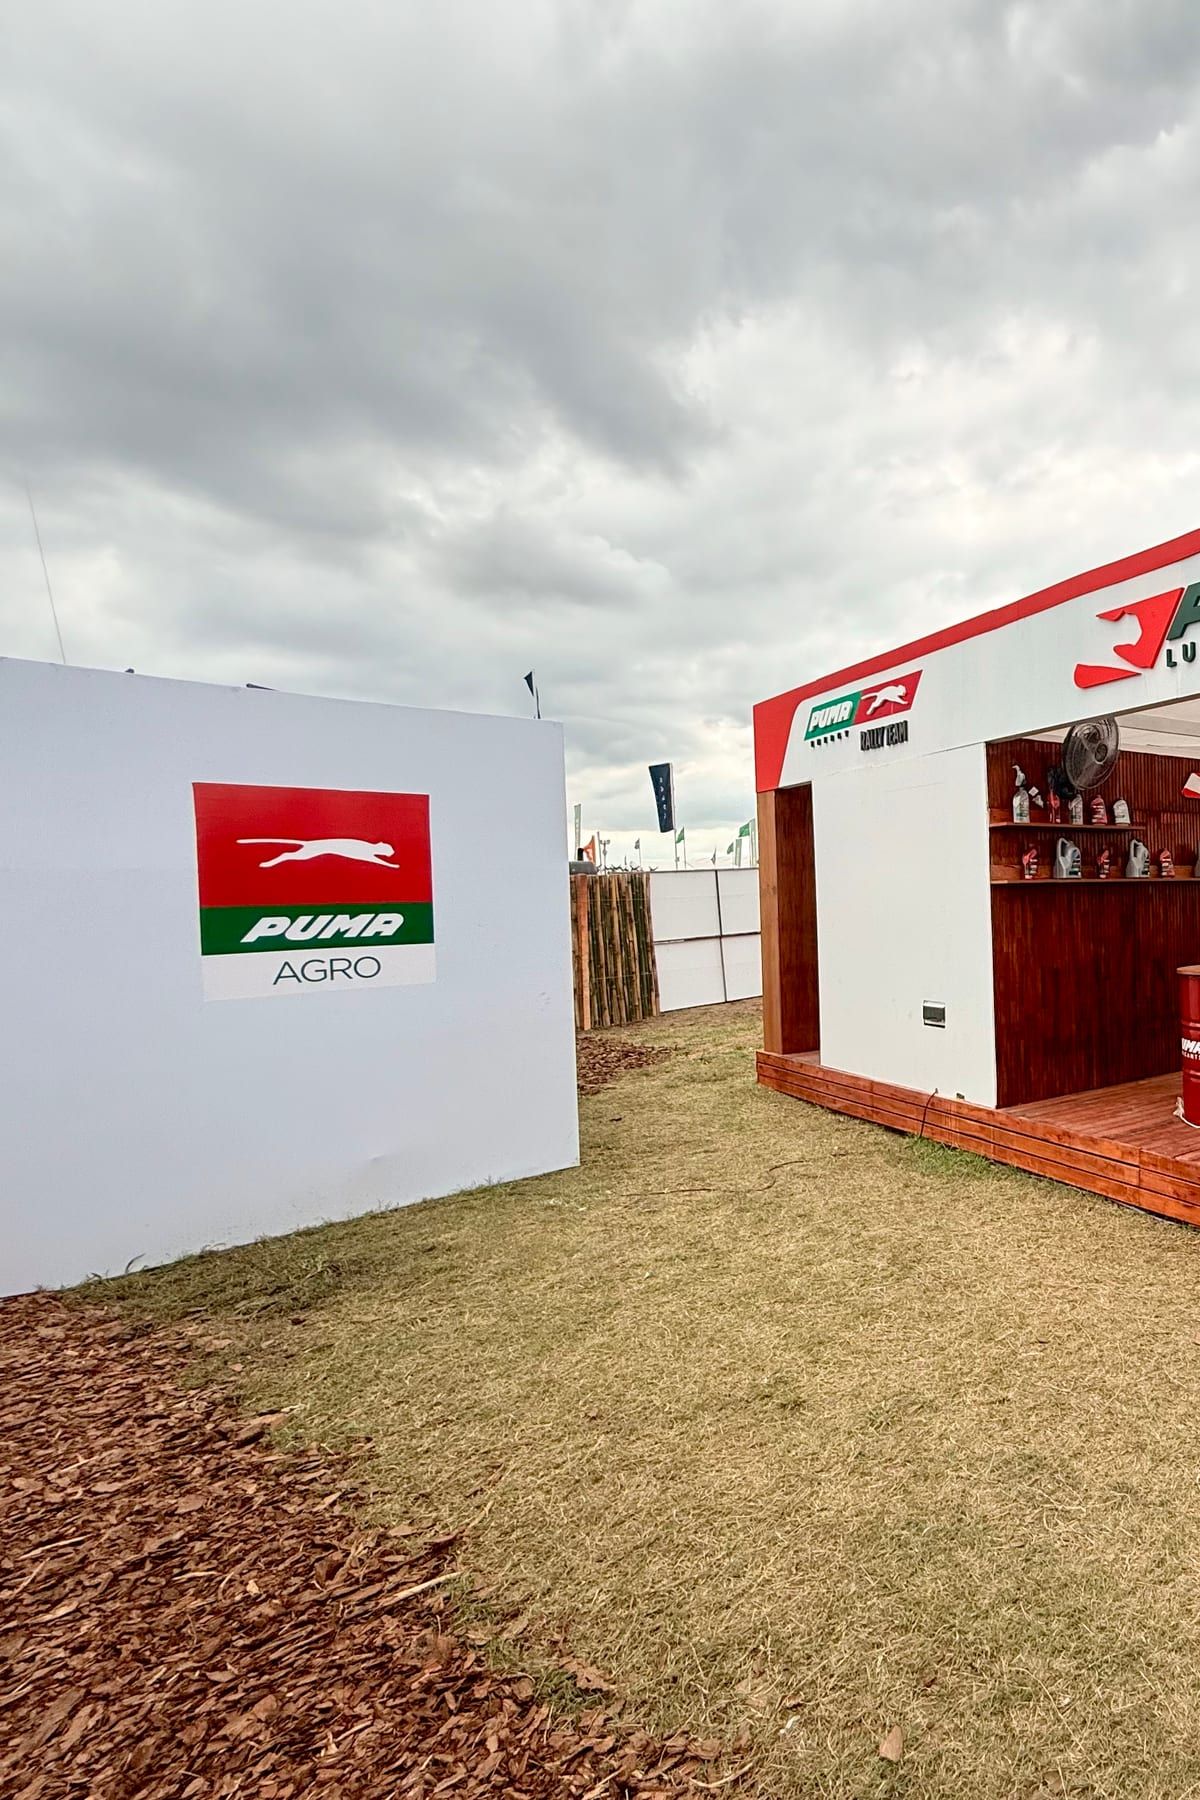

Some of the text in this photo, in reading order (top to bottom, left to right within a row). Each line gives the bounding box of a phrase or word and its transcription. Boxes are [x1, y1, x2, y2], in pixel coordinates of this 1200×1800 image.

[808, 700, 853, 733] PUMA
[860, 720, 909, 751] RALLY TEAM
[240, 913, 405, 943] PUMA
[272, 956, 382, 986] AGRO
